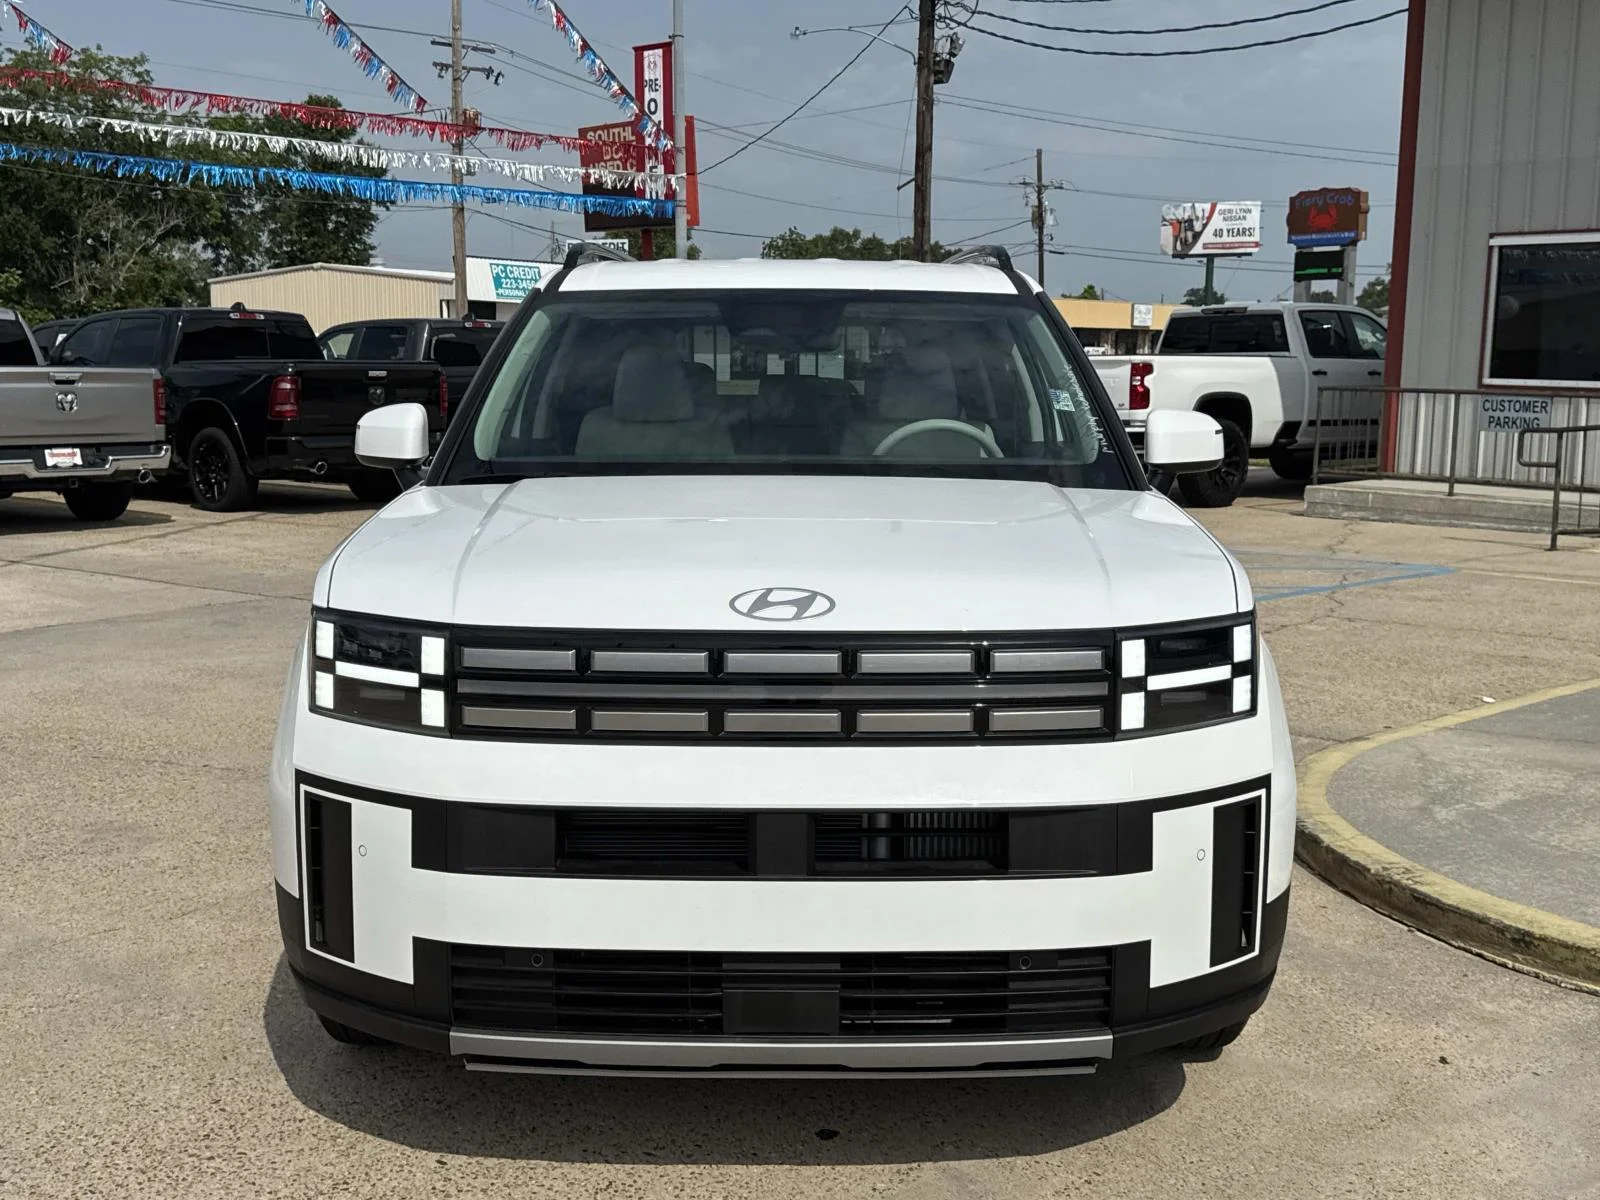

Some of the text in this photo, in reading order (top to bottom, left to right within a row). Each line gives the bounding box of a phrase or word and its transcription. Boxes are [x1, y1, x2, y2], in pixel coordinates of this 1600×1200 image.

[1217, 207, 1252, 216] GERI LYNN
[1212, 226, 1256, 238] 40 YEARS!
[491, 264, 540, 280] PC CREDIT
[1482, 398, 1549, 414] CUSTOMER
[1487, 415, 1540, 430] PARKING
